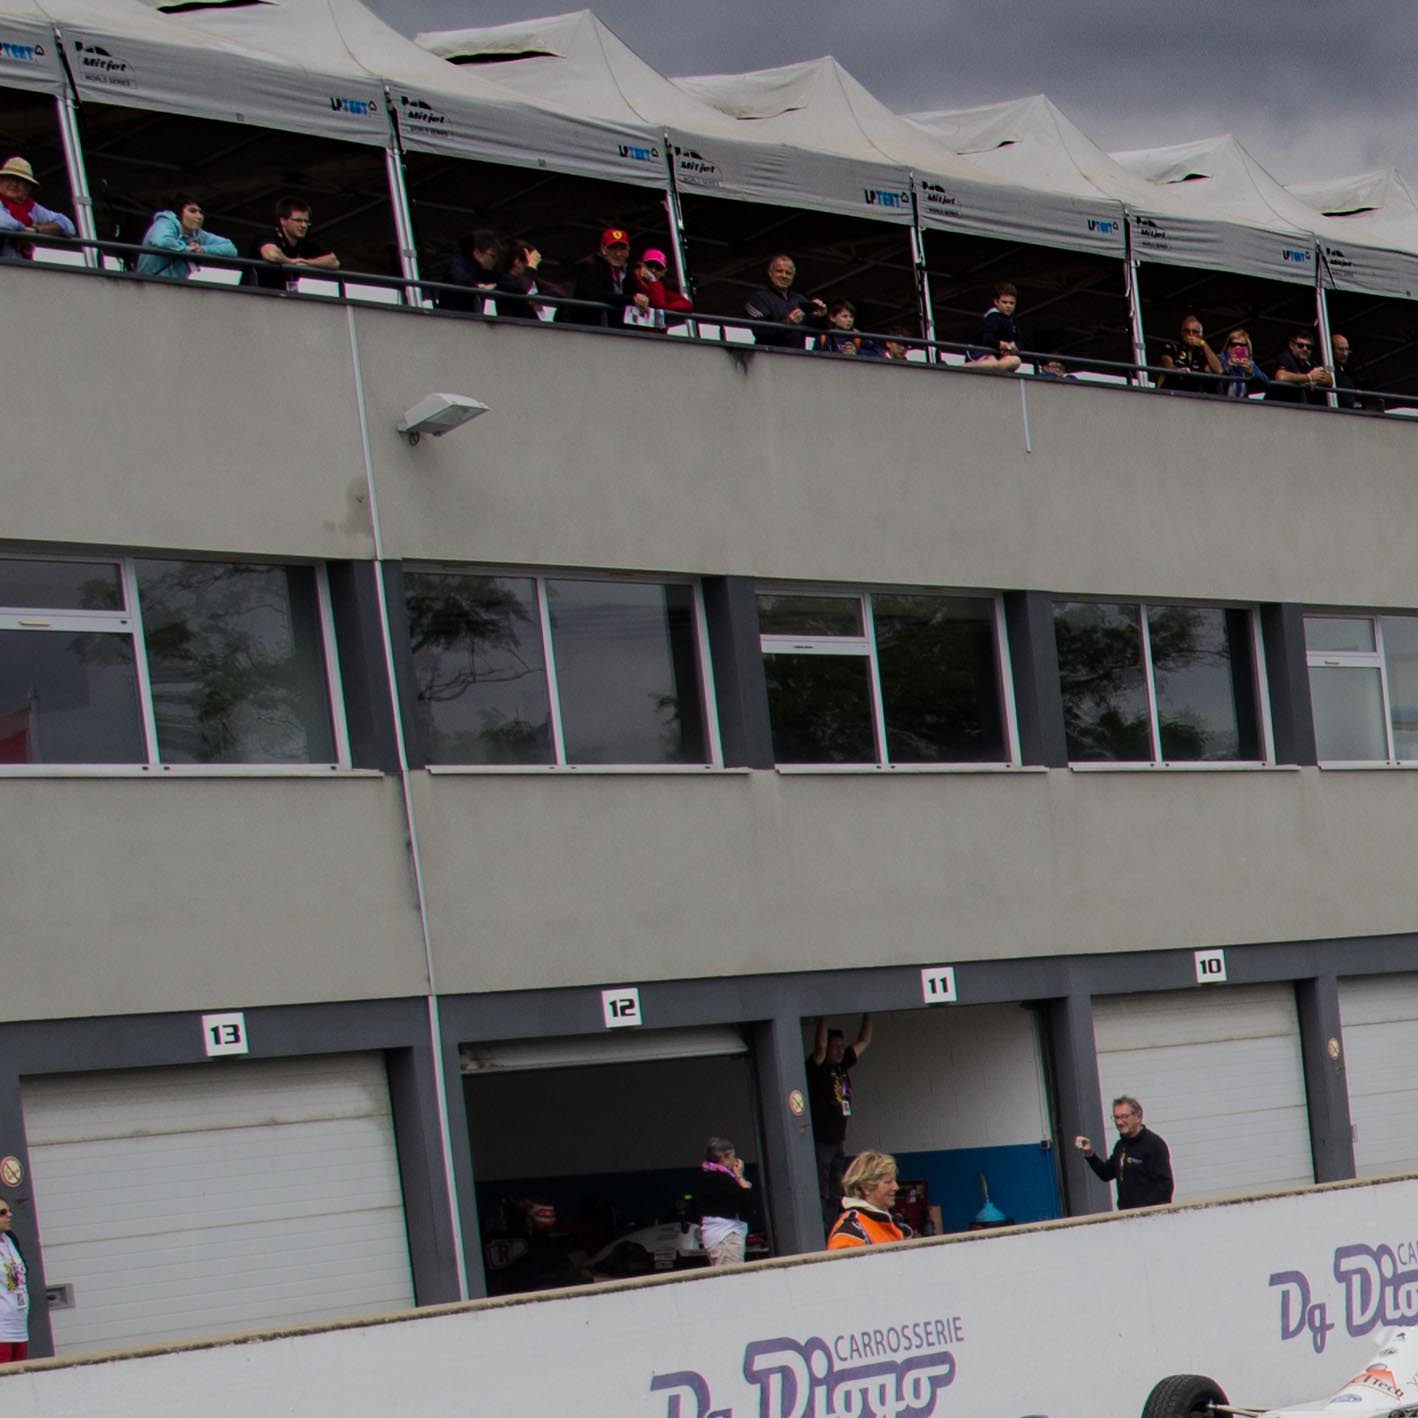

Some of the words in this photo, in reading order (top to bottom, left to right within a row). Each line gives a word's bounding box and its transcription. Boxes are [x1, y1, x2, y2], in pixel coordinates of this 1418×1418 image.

[1200, 959, 1221, 974] 10
[928, 977, 948, 994] 11
[609, 998, 636, 1017] 12
[211, 1024, 240, 1046] 13
[834, 1316, 965, 1362] CARROSSERIE
